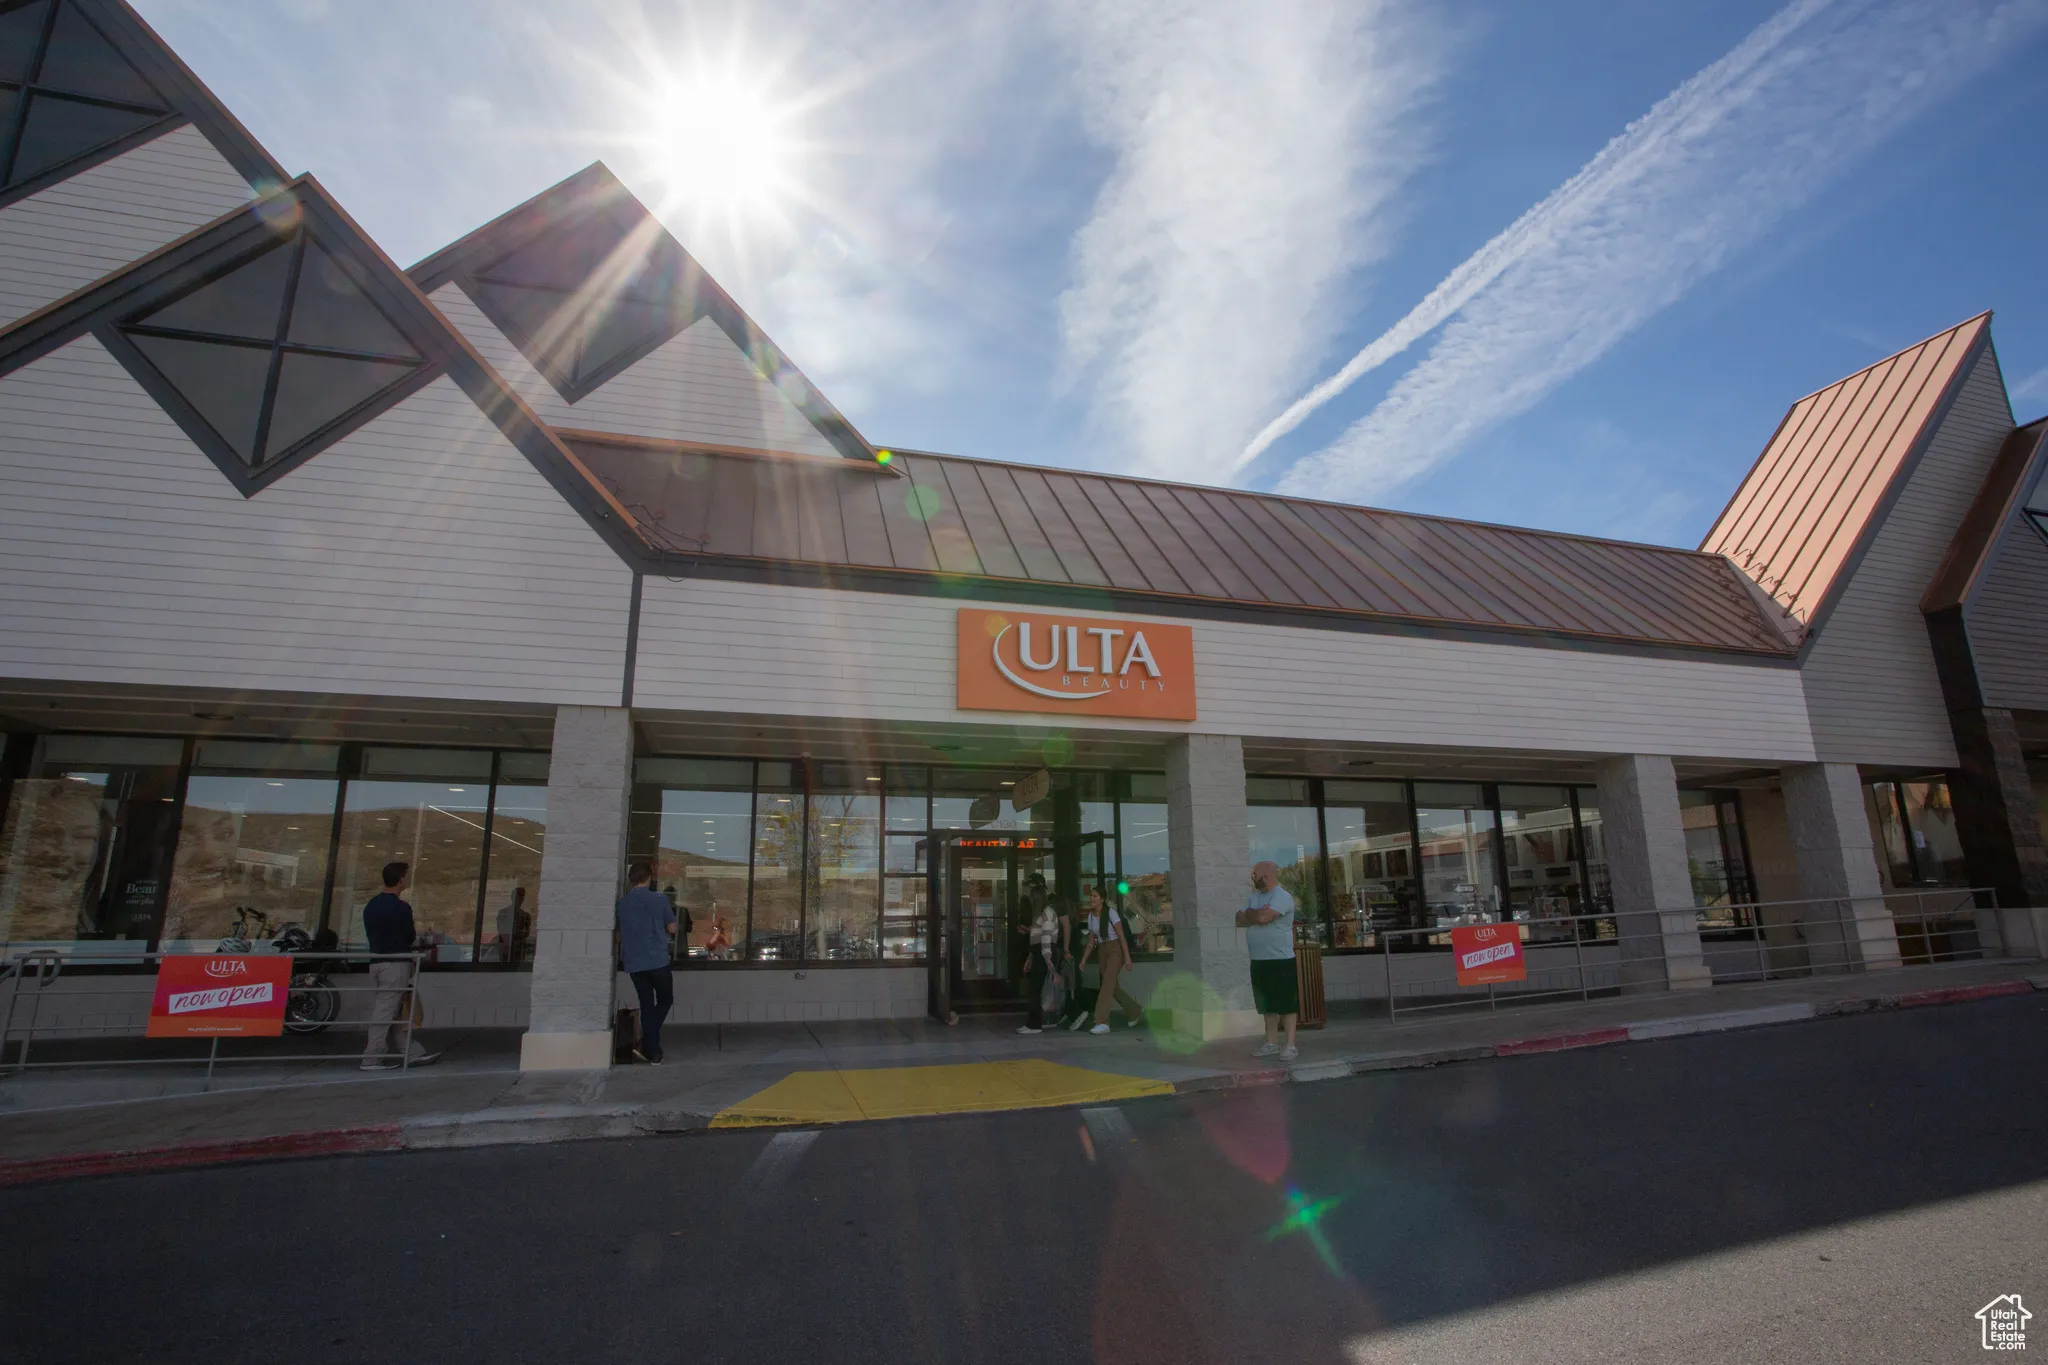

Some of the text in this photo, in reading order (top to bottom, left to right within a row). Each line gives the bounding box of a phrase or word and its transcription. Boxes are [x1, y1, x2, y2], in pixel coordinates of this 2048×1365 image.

[1018, 621, 1162, 678] ULTA
[1062, 675, 1166, 692] BEAUTY
[211, 960, 247, 972] ULTA
[1466, 944, 1512, 966] now open
[174, 985, 269, 1010] now open
